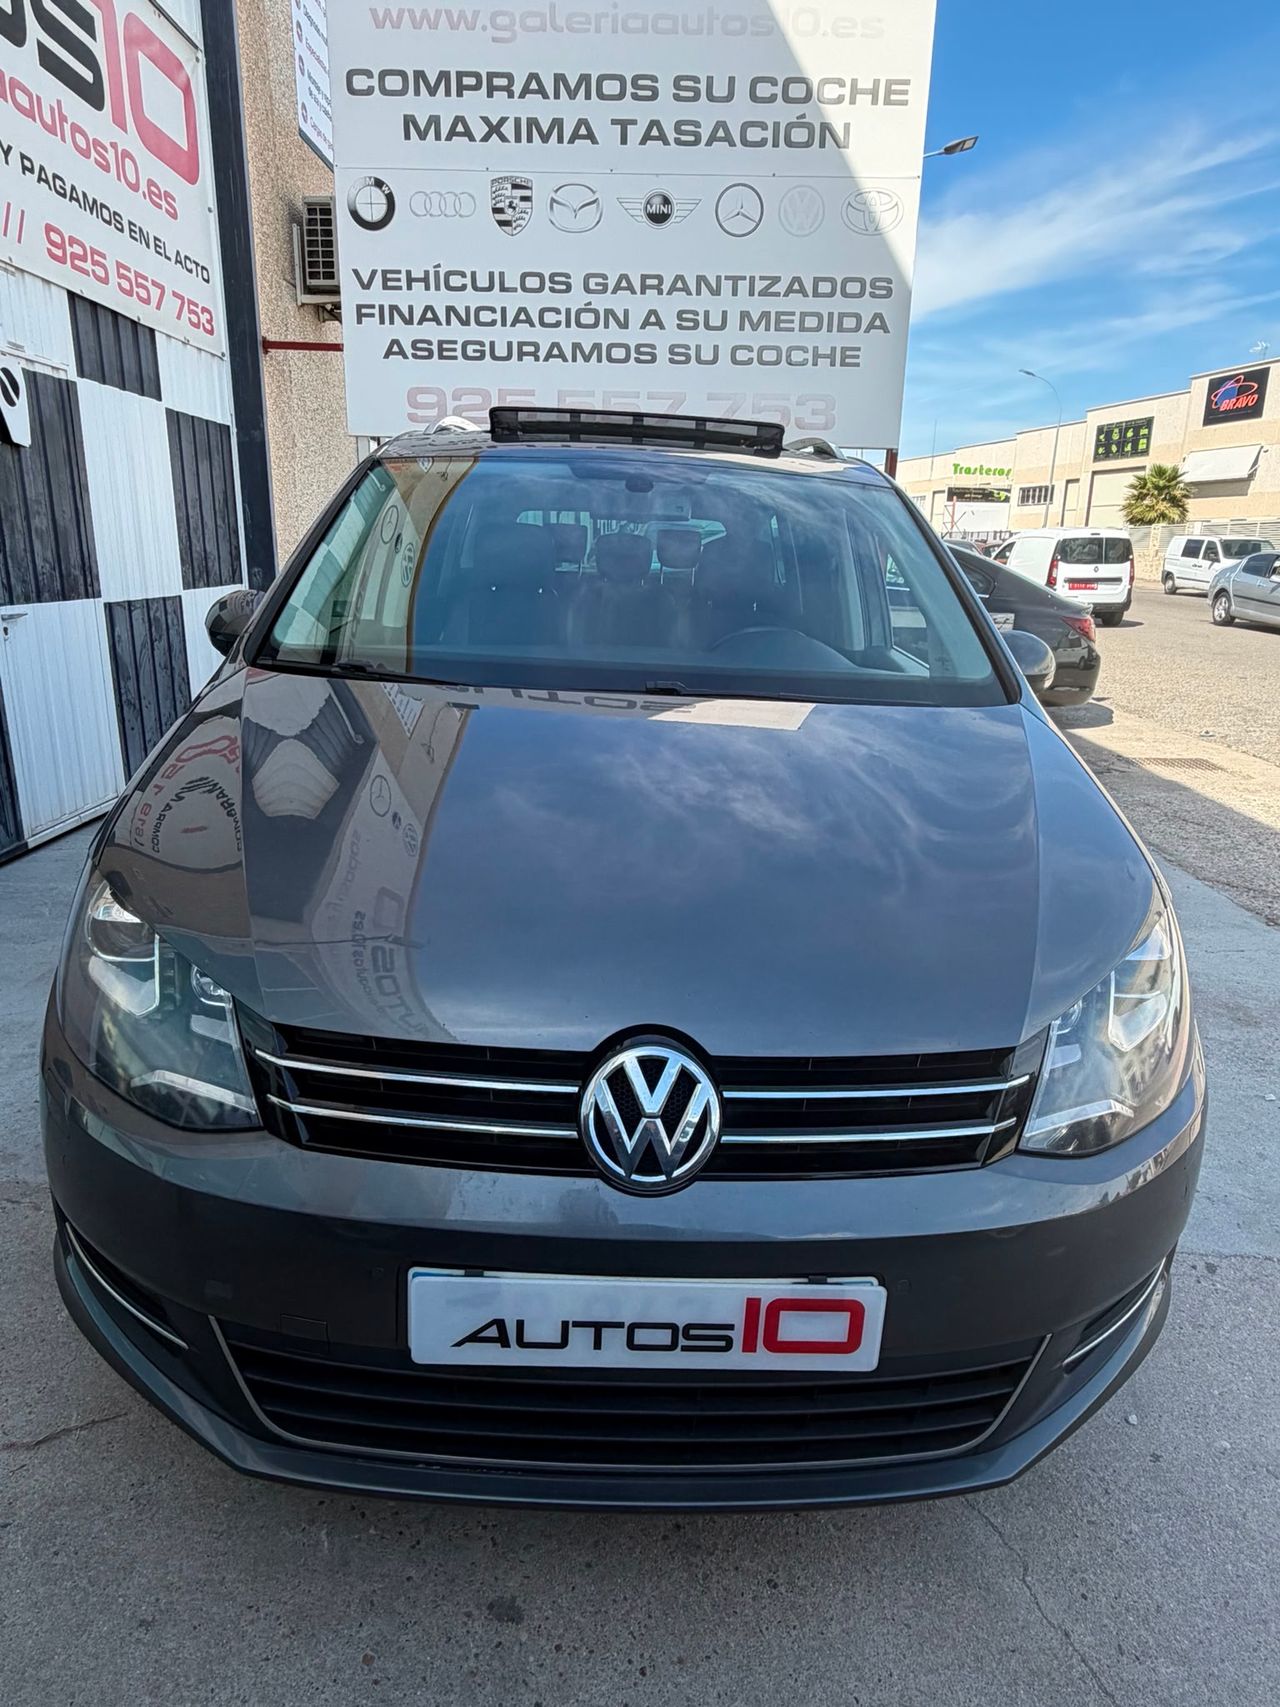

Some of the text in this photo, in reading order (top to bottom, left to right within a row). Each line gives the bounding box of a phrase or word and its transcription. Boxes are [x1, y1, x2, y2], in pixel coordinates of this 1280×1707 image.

[346, 68, 660, 102] COMPRAMOS
[672, 74, 736, 103] SU
[749, 75, 911, 106] COCHE
[403, 112, 851, 149] MAXIMA TASACIÓN
[0, 138, 210, 284] Y PAGAMOS EN EL ACTO
[646, 203, 672, 215] MINI
[45, 222, 109, 286] 925
[115, 259, 165, 311] 557
[172, 290, 215, 336] 753
[352, 263, 893, 299] VEHÍCULOS GARANTIZADOS
[355, 301, 890, 334] FINANCIACIÓN A SU MEDIDA
[382, 338, 861, 368] ASEGURAMOS SU COCHE
[707, 391, 836, 430] 753
[1220, 394, 1258, 411] BRAVO
[953, 463, 1012, 477] Trasteros
[450, 1297, 865, 1354] AUTOS10
